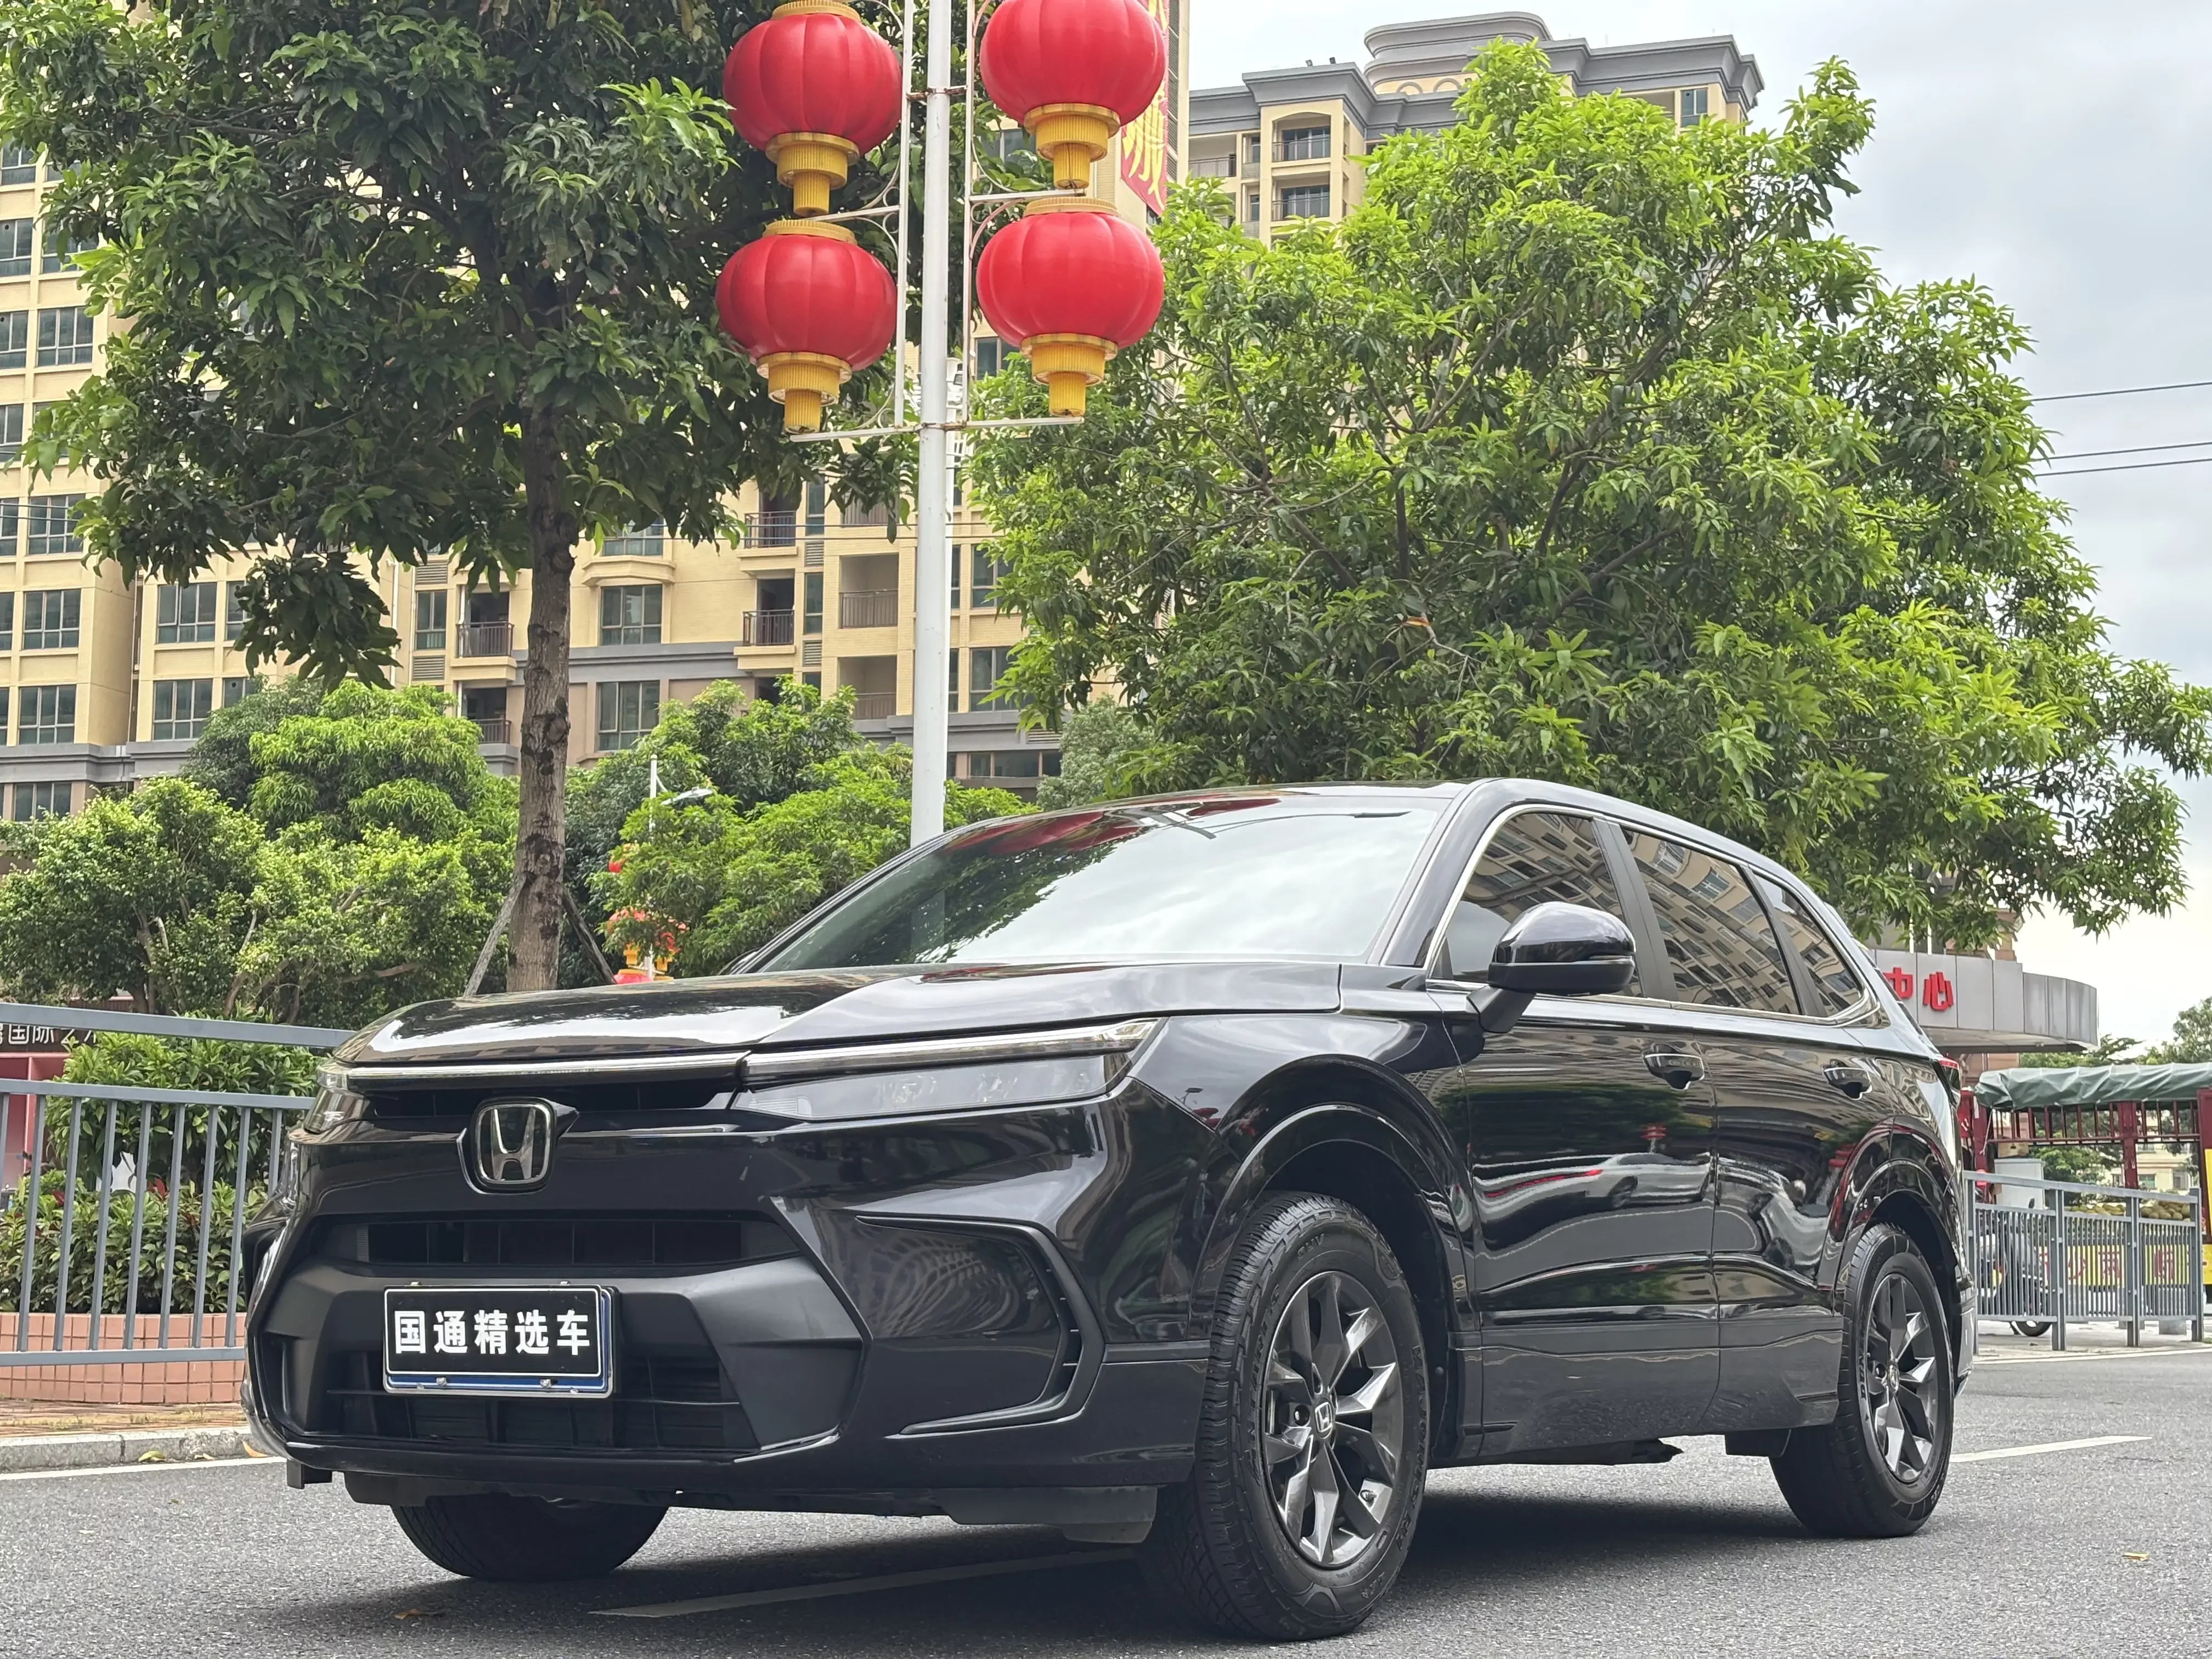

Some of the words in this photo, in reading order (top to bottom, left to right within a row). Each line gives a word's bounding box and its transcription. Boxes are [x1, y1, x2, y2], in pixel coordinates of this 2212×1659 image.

[1882, 967, 1954, 1011] 中心
[1296, 1232, 1325, 1261] SUV
[394, 1309, 590, 1356] 国通精选车
[1412, 1344, 1427, 1509] MAJORIS
